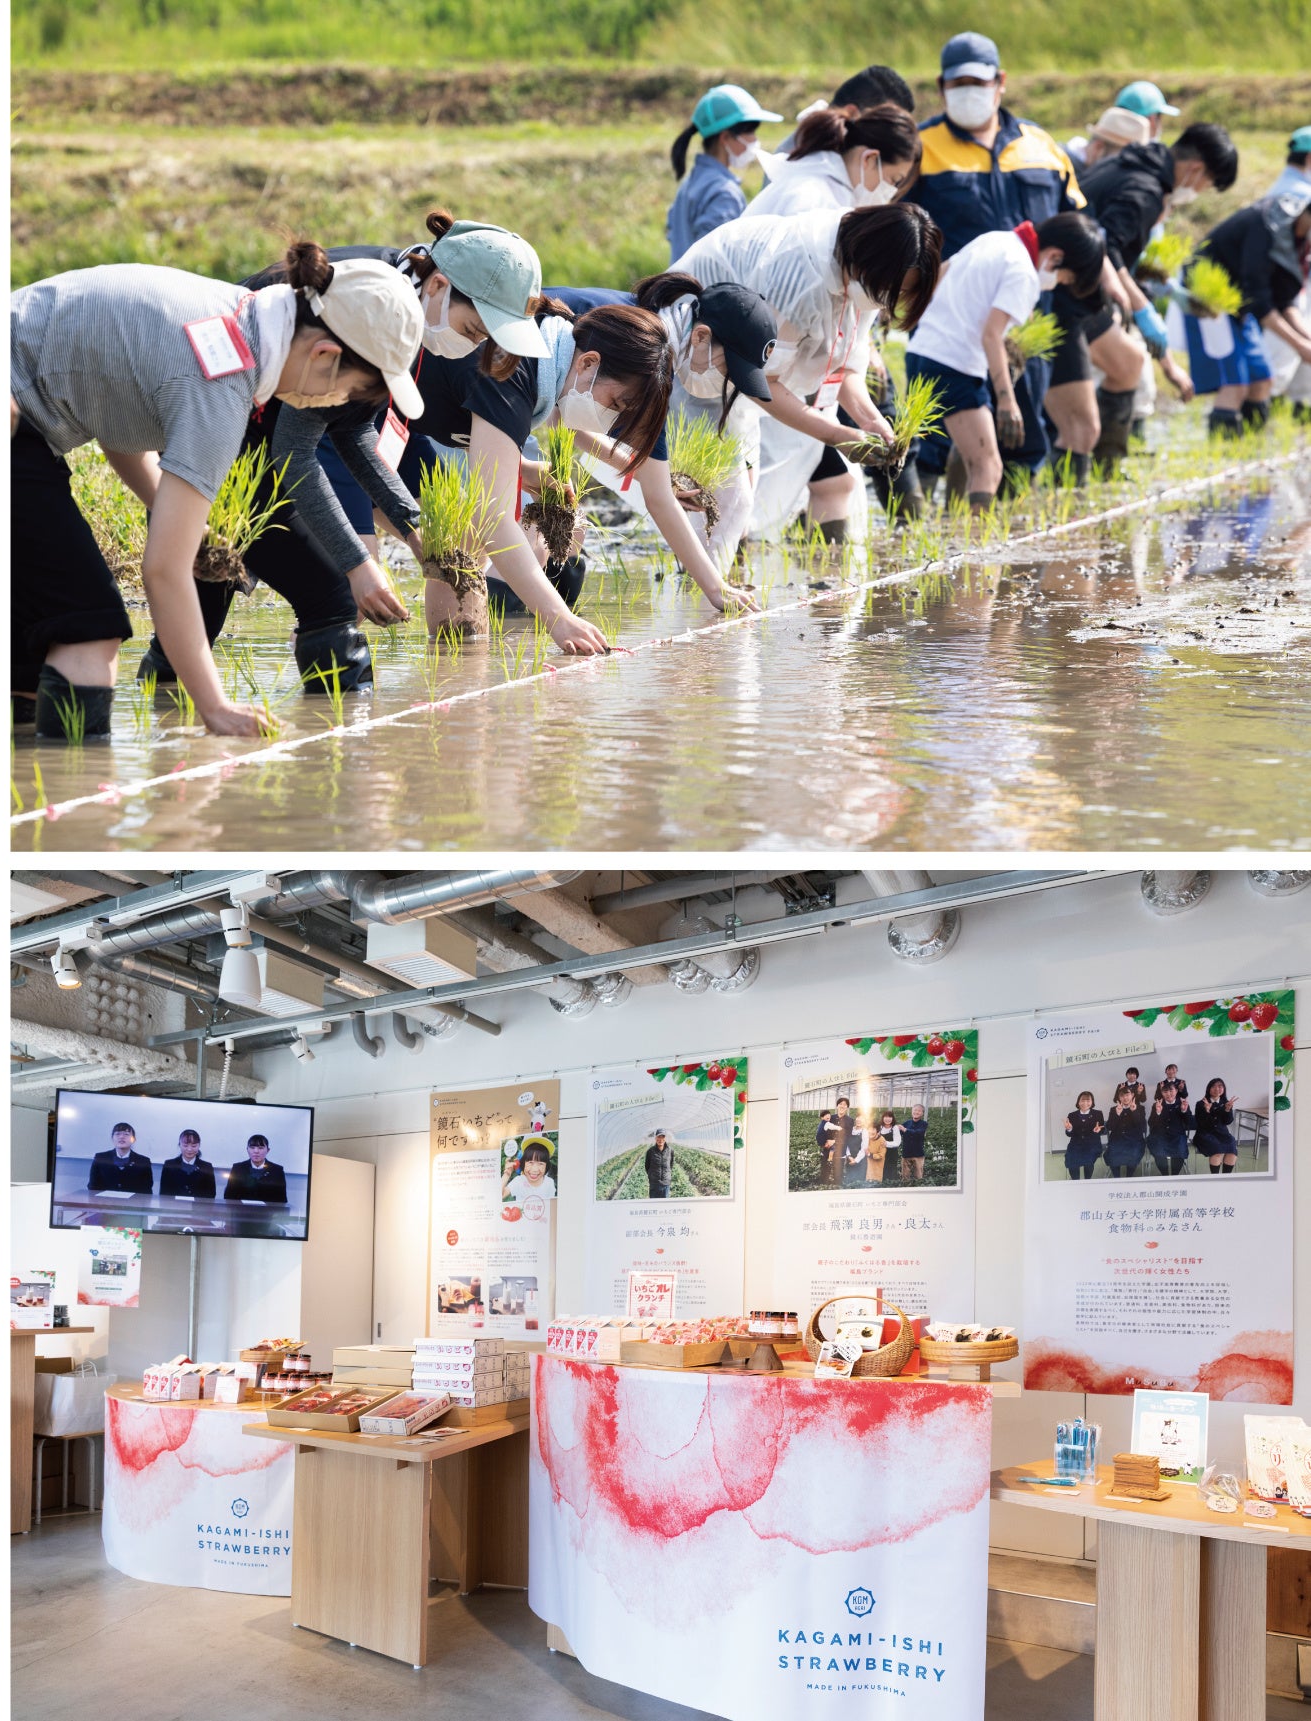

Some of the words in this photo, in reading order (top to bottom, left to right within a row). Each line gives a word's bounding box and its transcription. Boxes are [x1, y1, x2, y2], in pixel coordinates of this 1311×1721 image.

[1080, 1206, 1235, 1221] 郡山女子大学附属高等学校
[1108, 1222, 1203, 1234] 食物科のみなさん
[637, 1294, 665, 1302] クランチ
[197, 1524, 289, 1539] KAGAMI-ISHI
[198, 1540, 291, 1555] STRAWBERRY
[852, 1595, 869, 1605] KGM
[778, 1629, 943, 1655] KAGAMI-ISHI
[778, 1655, 946, 1682] STRAWBERRY
[806, 1683, 833, 1691] MADE
[851, 1684, 906, 1697] FUKUSHIMA
